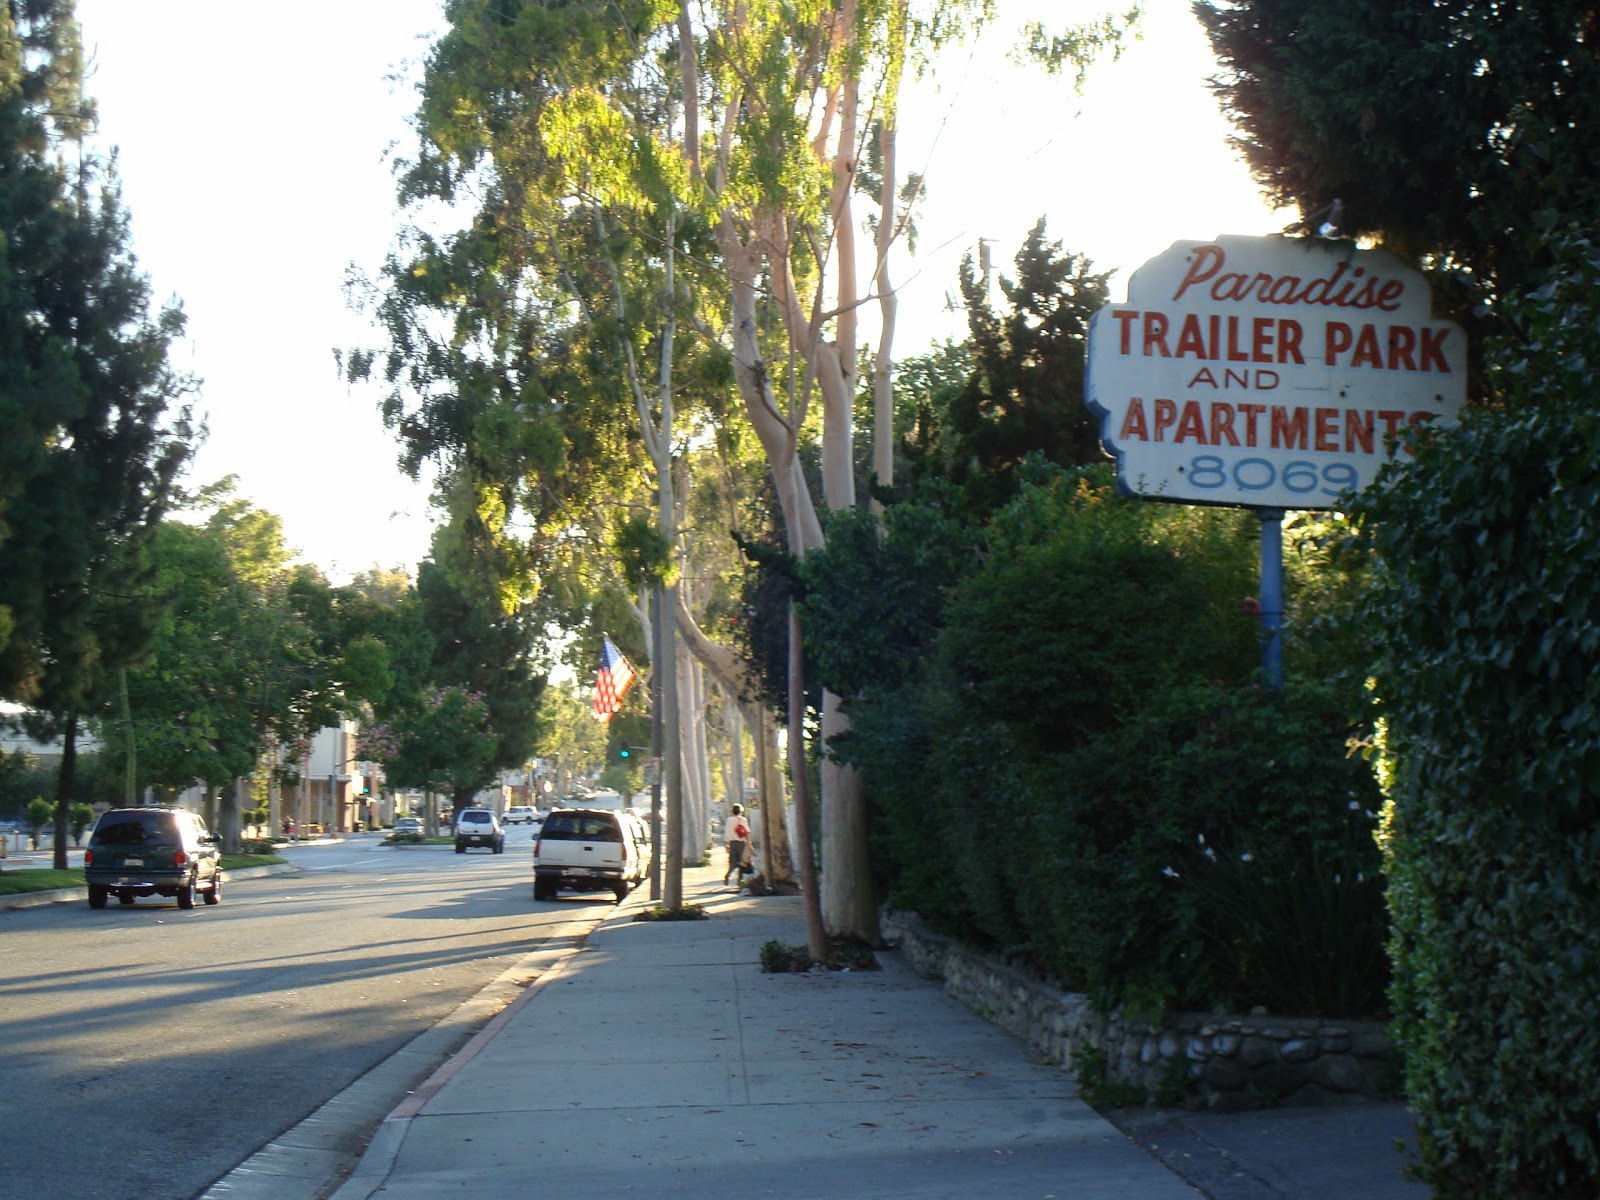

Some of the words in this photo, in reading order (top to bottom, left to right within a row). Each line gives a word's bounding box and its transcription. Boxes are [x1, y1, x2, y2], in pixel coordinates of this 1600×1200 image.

[1173, 245, 1405, 311] Paradise
[1112, 310, 1306, 365] TRAILER
[1325, 321, 1452, 374] PARK
[1188, 367, 1280, 390] AND
[1187, 455, 1359, 497] 8069
